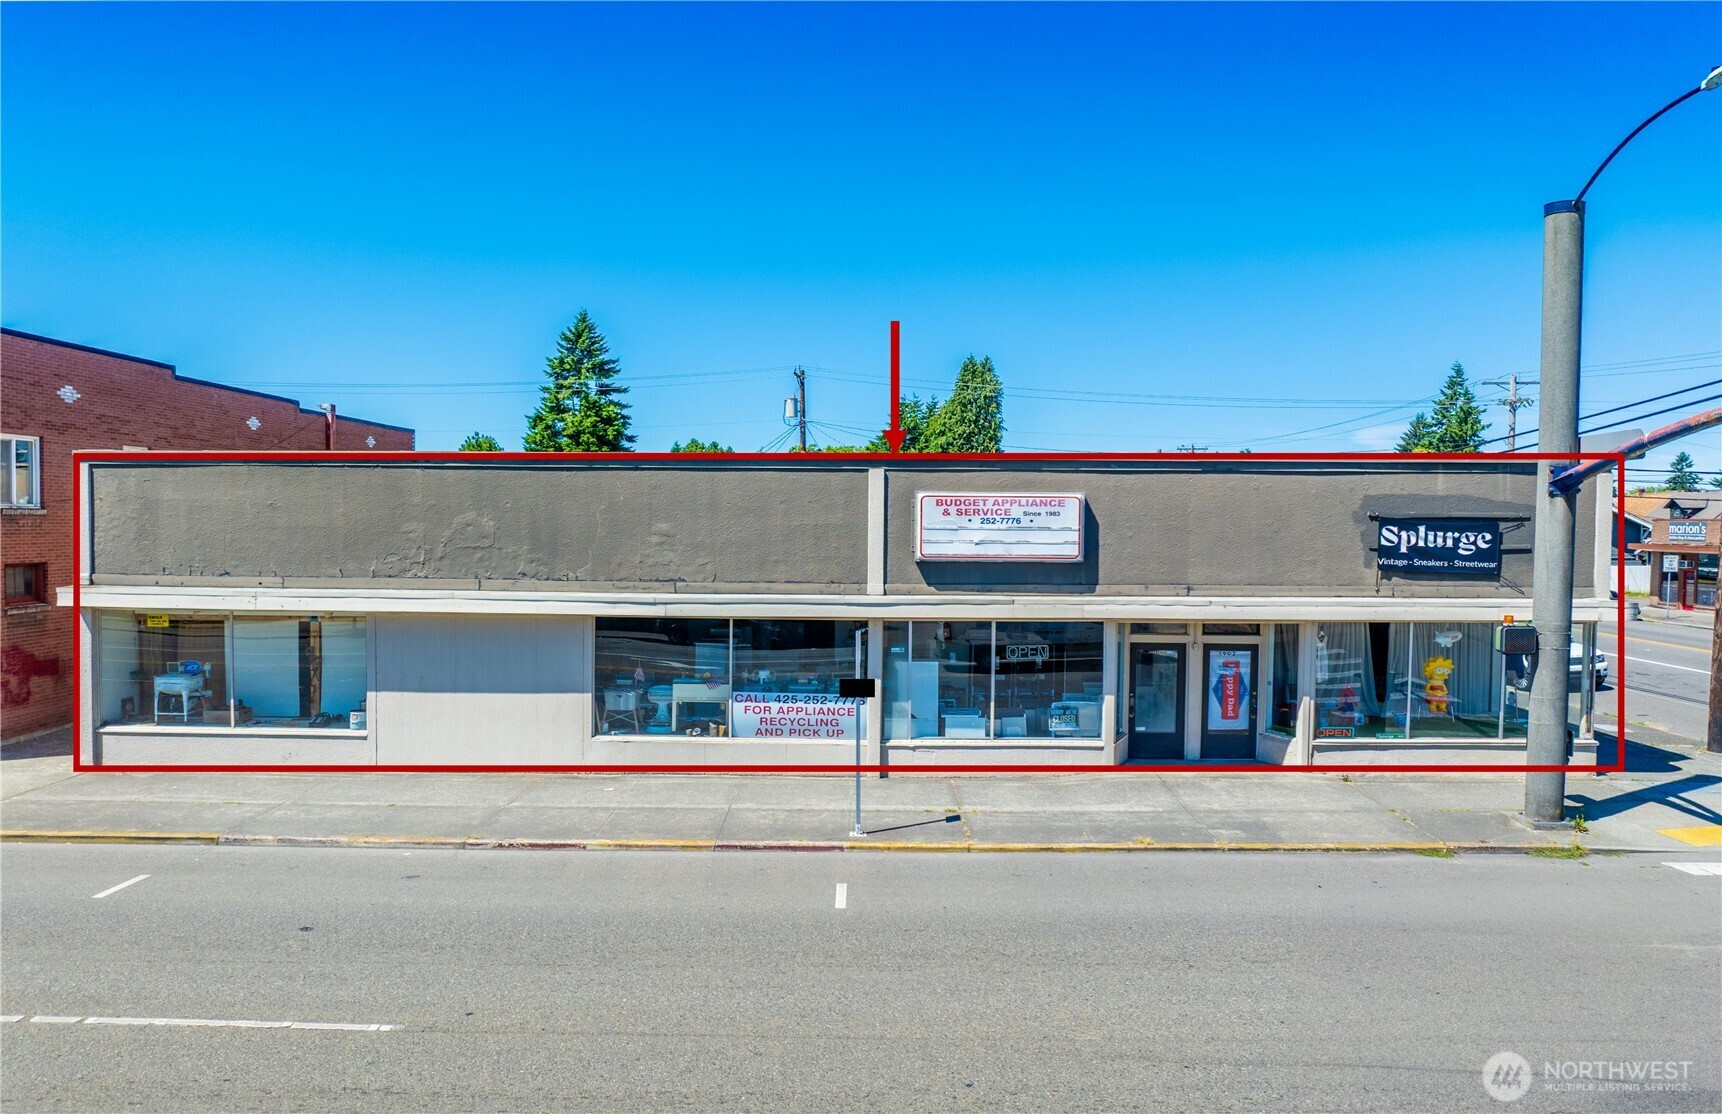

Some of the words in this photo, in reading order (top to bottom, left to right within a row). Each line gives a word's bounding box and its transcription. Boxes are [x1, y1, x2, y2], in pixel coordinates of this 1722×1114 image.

[935, 498, 989, 507] BUDGET
[992, 498, 1066, 508] APPLIANCE
[942, 508, 952, 517] &
[956, 508, 1012, 517] SERVICE
[980, 517, 1022, 525] 252-7776
[1669, 522, 1706, 534] marion's
[1380, 525, 1492, 555] Splurge
[1377, 557, 1408, 566] Vintage
[1413, 558, 1448, 567] Sneakers
[1454, 560, 1498, 568] Streetwear
[1008, 646, 1047, 658] OPEN
[734, 693, 770, 703] CALL
[744, 705, 772, 715] FOR
[776, 706, 855, 717] APPLIANCE
[1227, 698, 1235, 717] Dad
[759, 717, 840, 727] RECYCLING
[755, 727, 784, 737] AND
[788, 728, 821, 737] PICK
[826, 729, 845, 738] UP
[1317, 729, 1352, 737] OPEN
